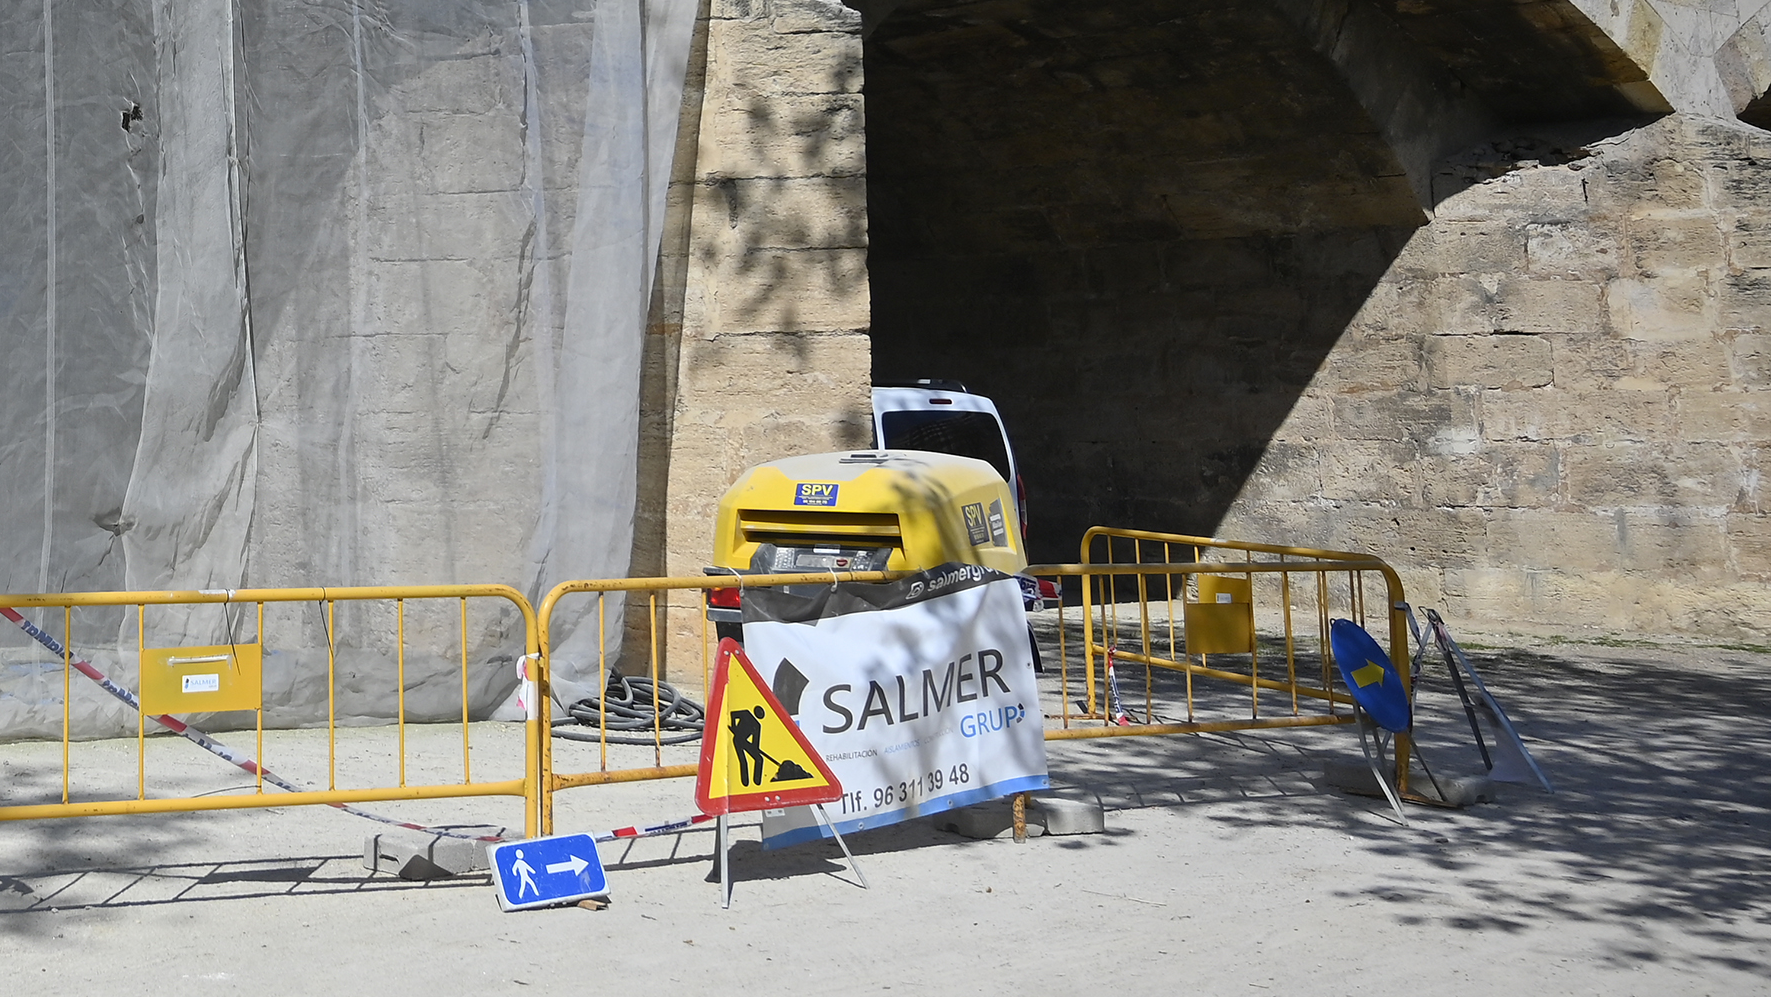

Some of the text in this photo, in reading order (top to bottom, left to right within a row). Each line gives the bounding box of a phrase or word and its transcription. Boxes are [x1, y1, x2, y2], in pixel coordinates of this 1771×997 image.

[801, 484, 833, 496] SPV
[965, 504, 982, 527] SPV
[822, 648, 1011, 734] SALMER
[960, 705, 1018, 738] GRUP
[841, 762, 970, 814] Tlf. 96 311 39 48
